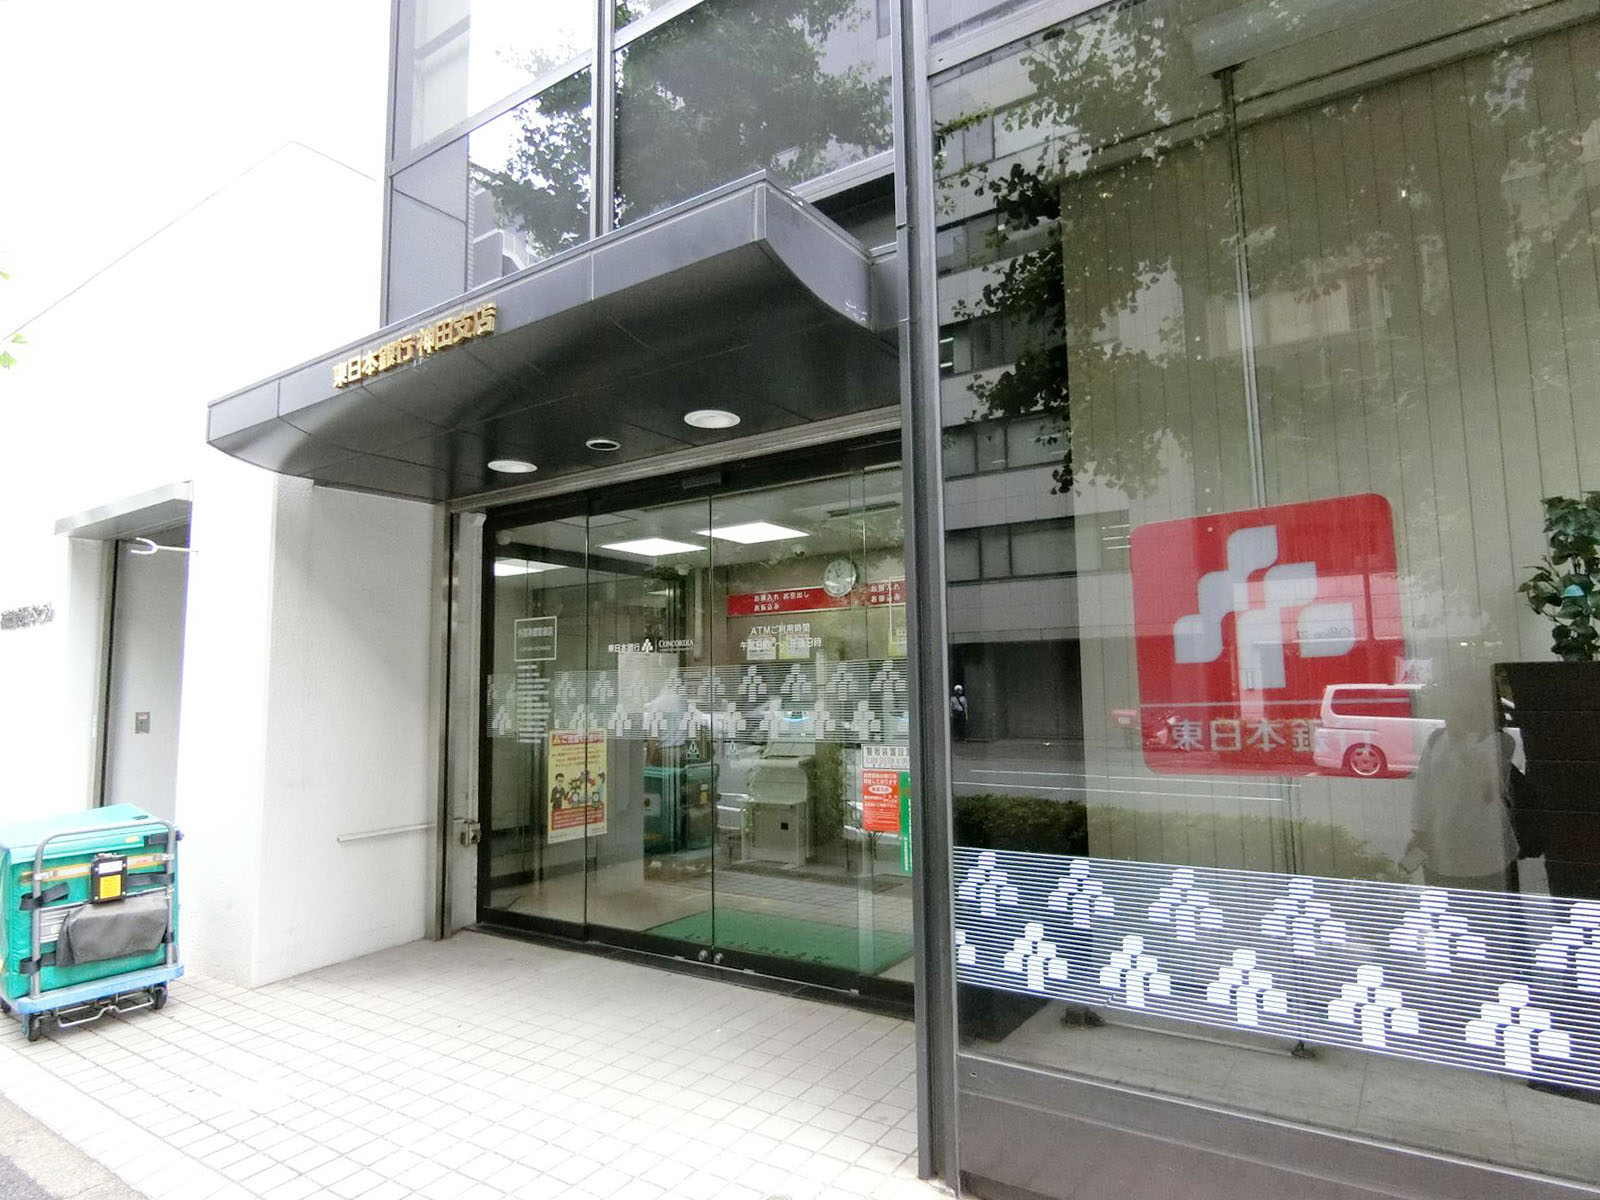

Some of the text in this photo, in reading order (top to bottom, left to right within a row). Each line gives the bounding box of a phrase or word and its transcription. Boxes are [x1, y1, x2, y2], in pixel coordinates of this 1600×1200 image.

[332, 302, 497, 388] 東日本銀行神田支店
[750, 622, 810, 636] ATMご利用時間
